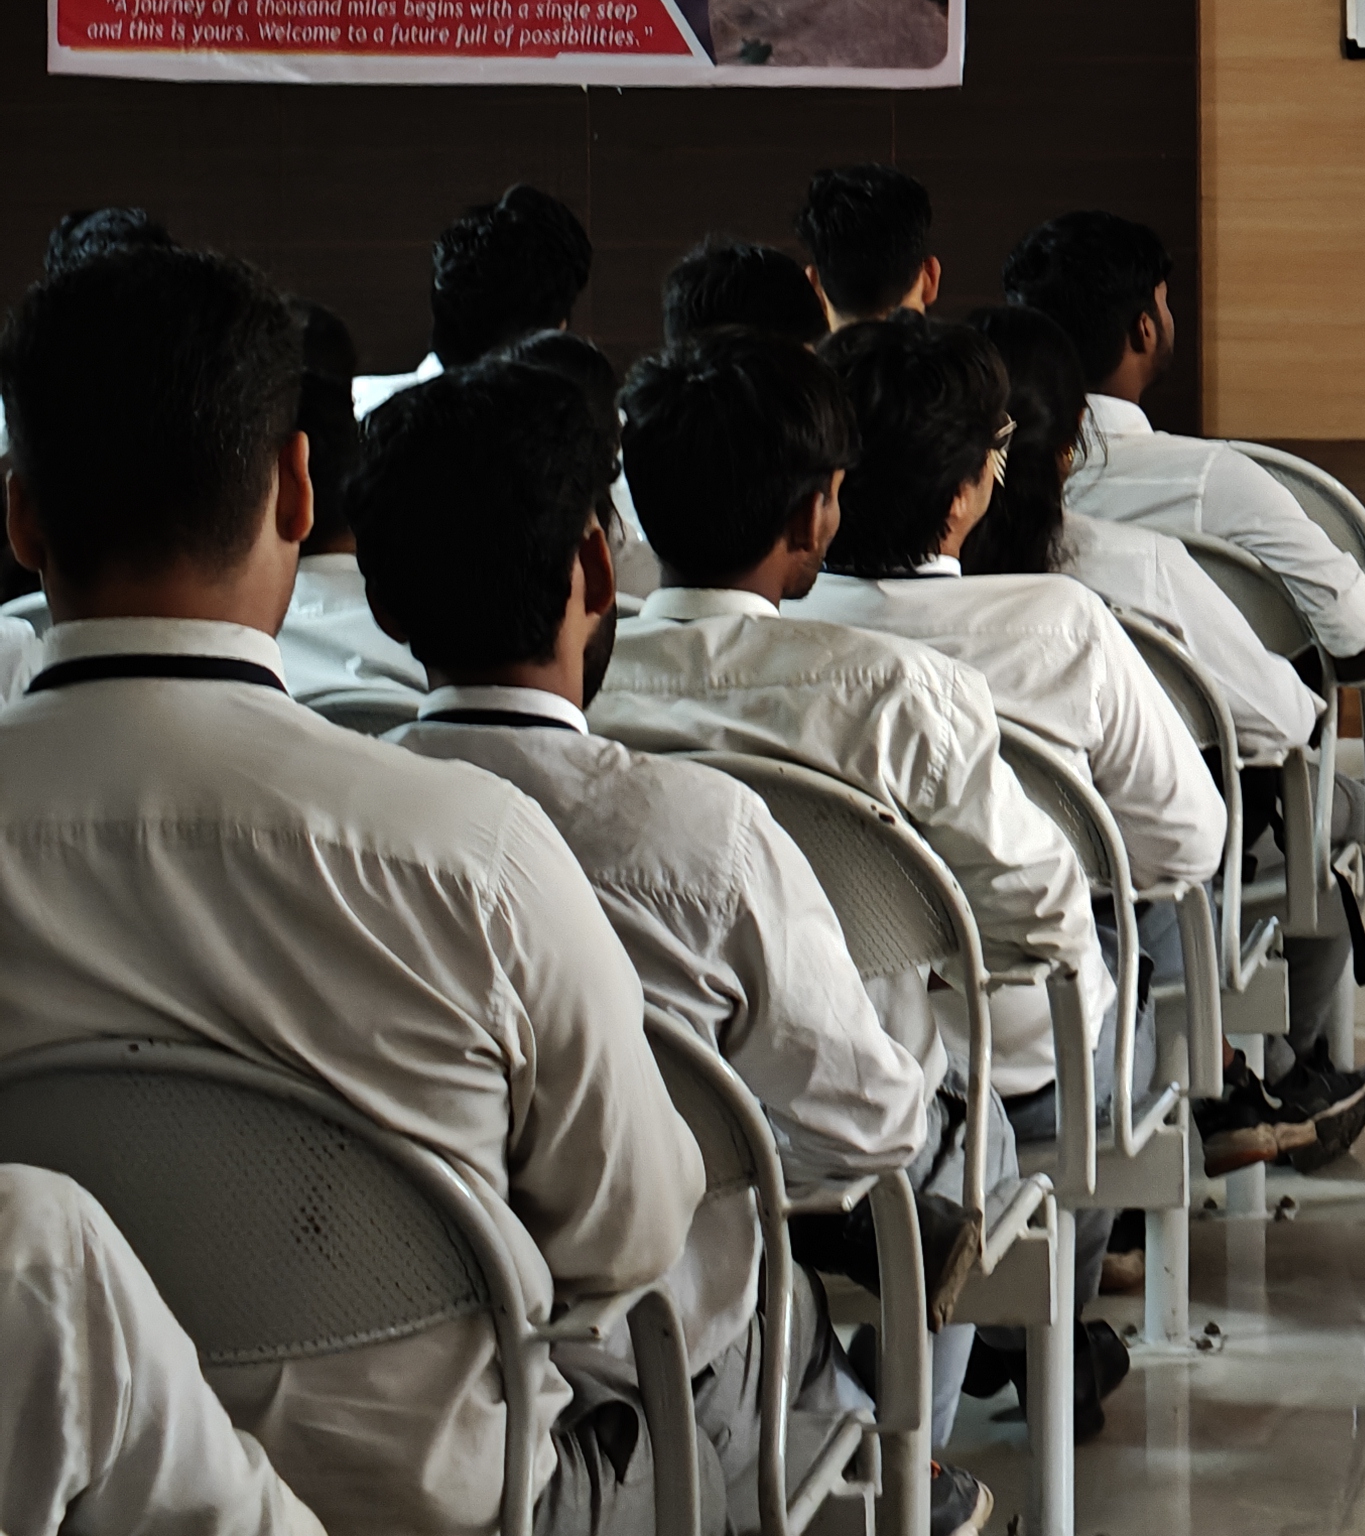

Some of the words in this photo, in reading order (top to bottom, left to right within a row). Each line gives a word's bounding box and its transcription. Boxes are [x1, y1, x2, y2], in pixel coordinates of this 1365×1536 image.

[238, 0, 248, 15] a
[518, 3, 529, 20] a
[536, 0, 590, 26] single
[597, 1, 638, 26] step
[88, 20, 122, 40] and
[129, 20, 163, 41] this
[171, 20, 185, 41] is
[193, 22, 250, 44] yours.
[258, 22, 341, 44] Welcome
[348, 23, 366, 44] to
[373, 26, 384, 44] a
[391, 24, 450, 47] future
[455, 25, 488, 48] full
[494, 25, 513, 48] of
